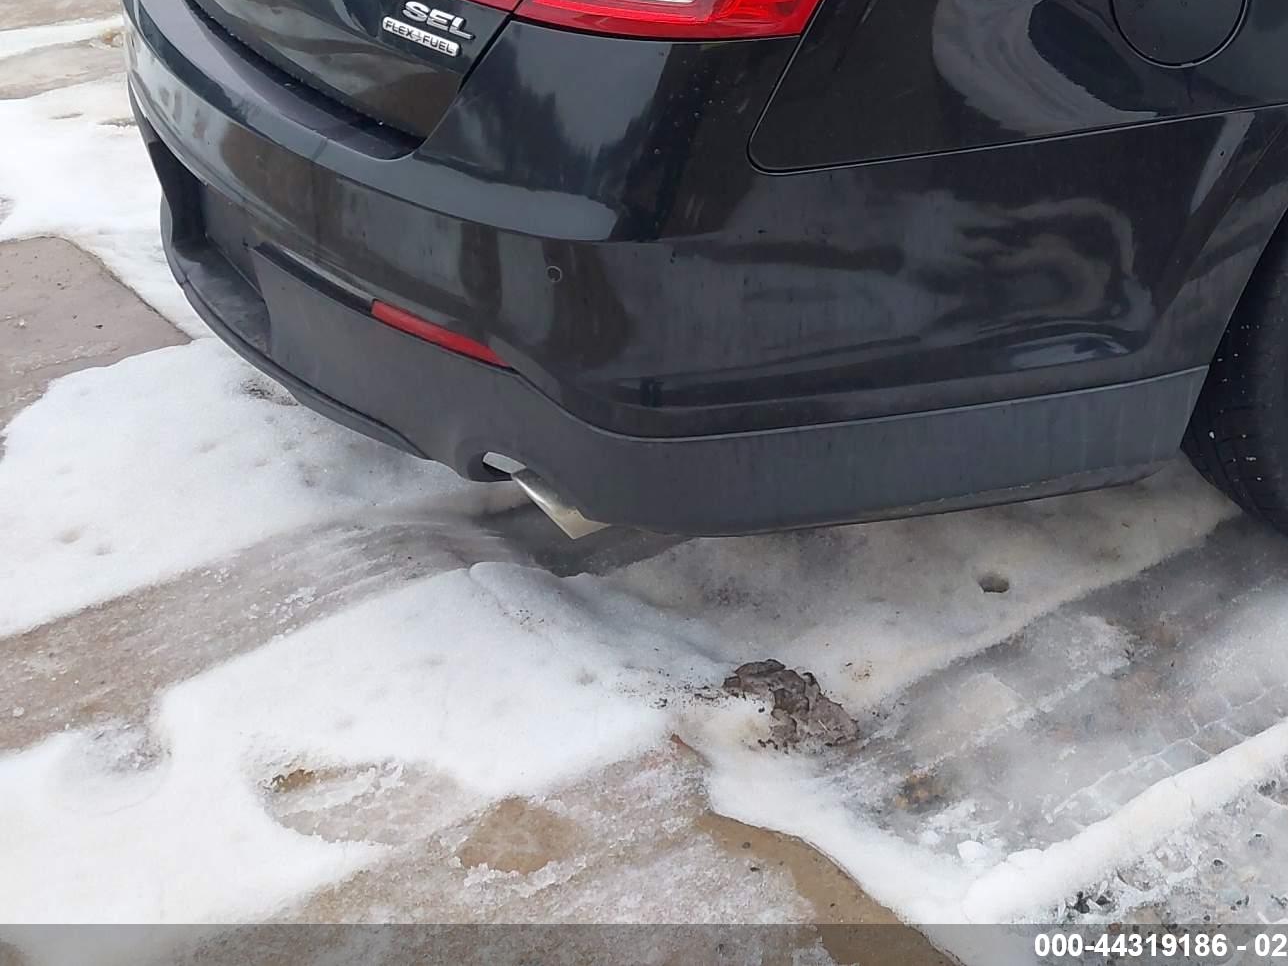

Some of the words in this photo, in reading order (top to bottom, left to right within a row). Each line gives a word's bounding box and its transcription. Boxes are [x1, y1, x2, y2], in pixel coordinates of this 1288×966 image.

[385, 20, 413, 38] FLEX
[422, 35, 454, 53] FUEL
[402, 0, 475, 40] SEL
